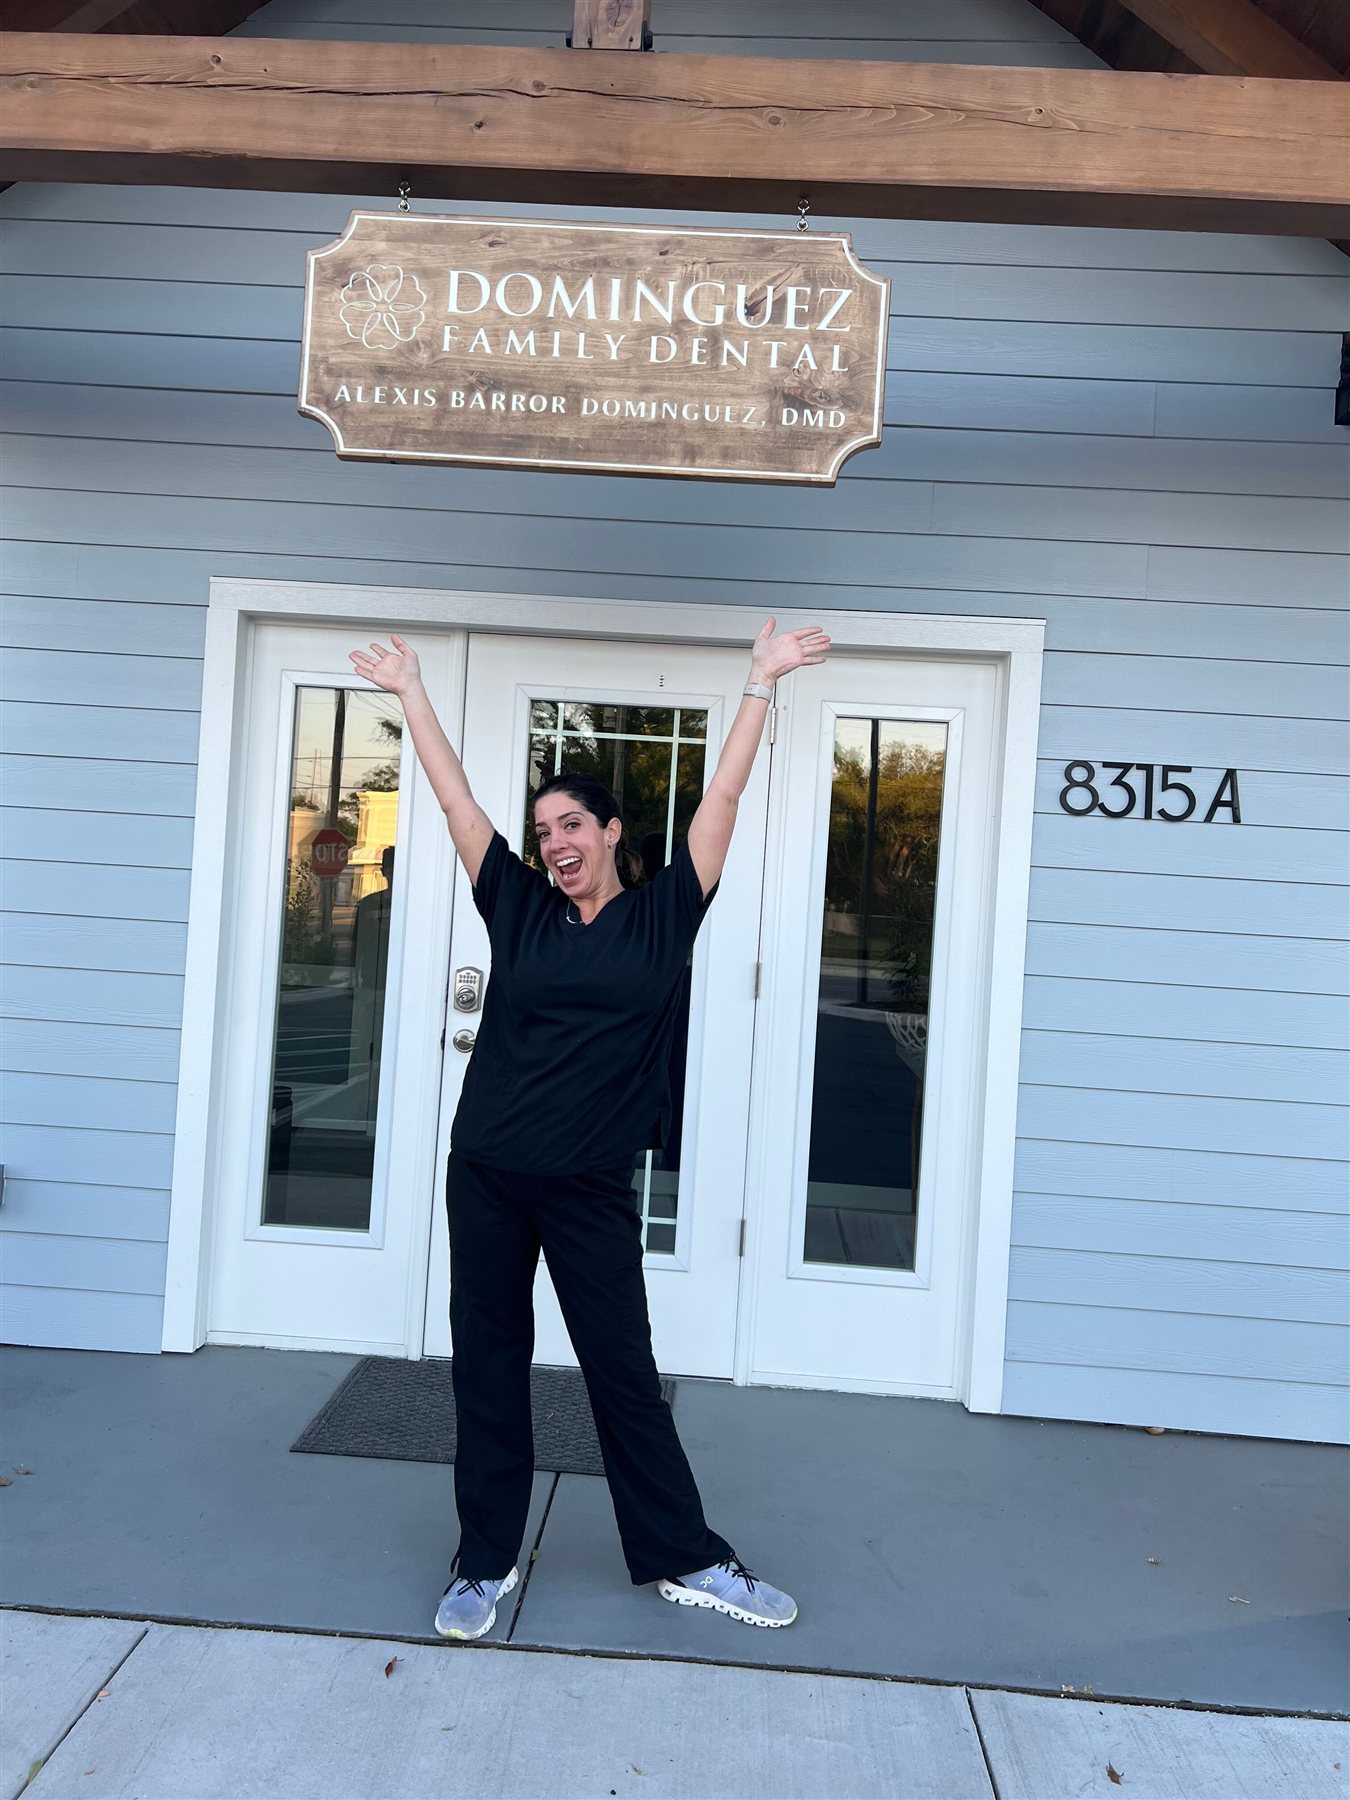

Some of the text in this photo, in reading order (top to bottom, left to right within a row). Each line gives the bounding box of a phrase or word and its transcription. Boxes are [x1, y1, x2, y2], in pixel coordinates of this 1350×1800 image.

[447, 270, 853, 332] DOMINGUEZ
[442, 325, 850, 372] FAMILY DENTAL
[334, 384, 847, 429] ALEXIS BARROR DOMINGUEZ, DMD
